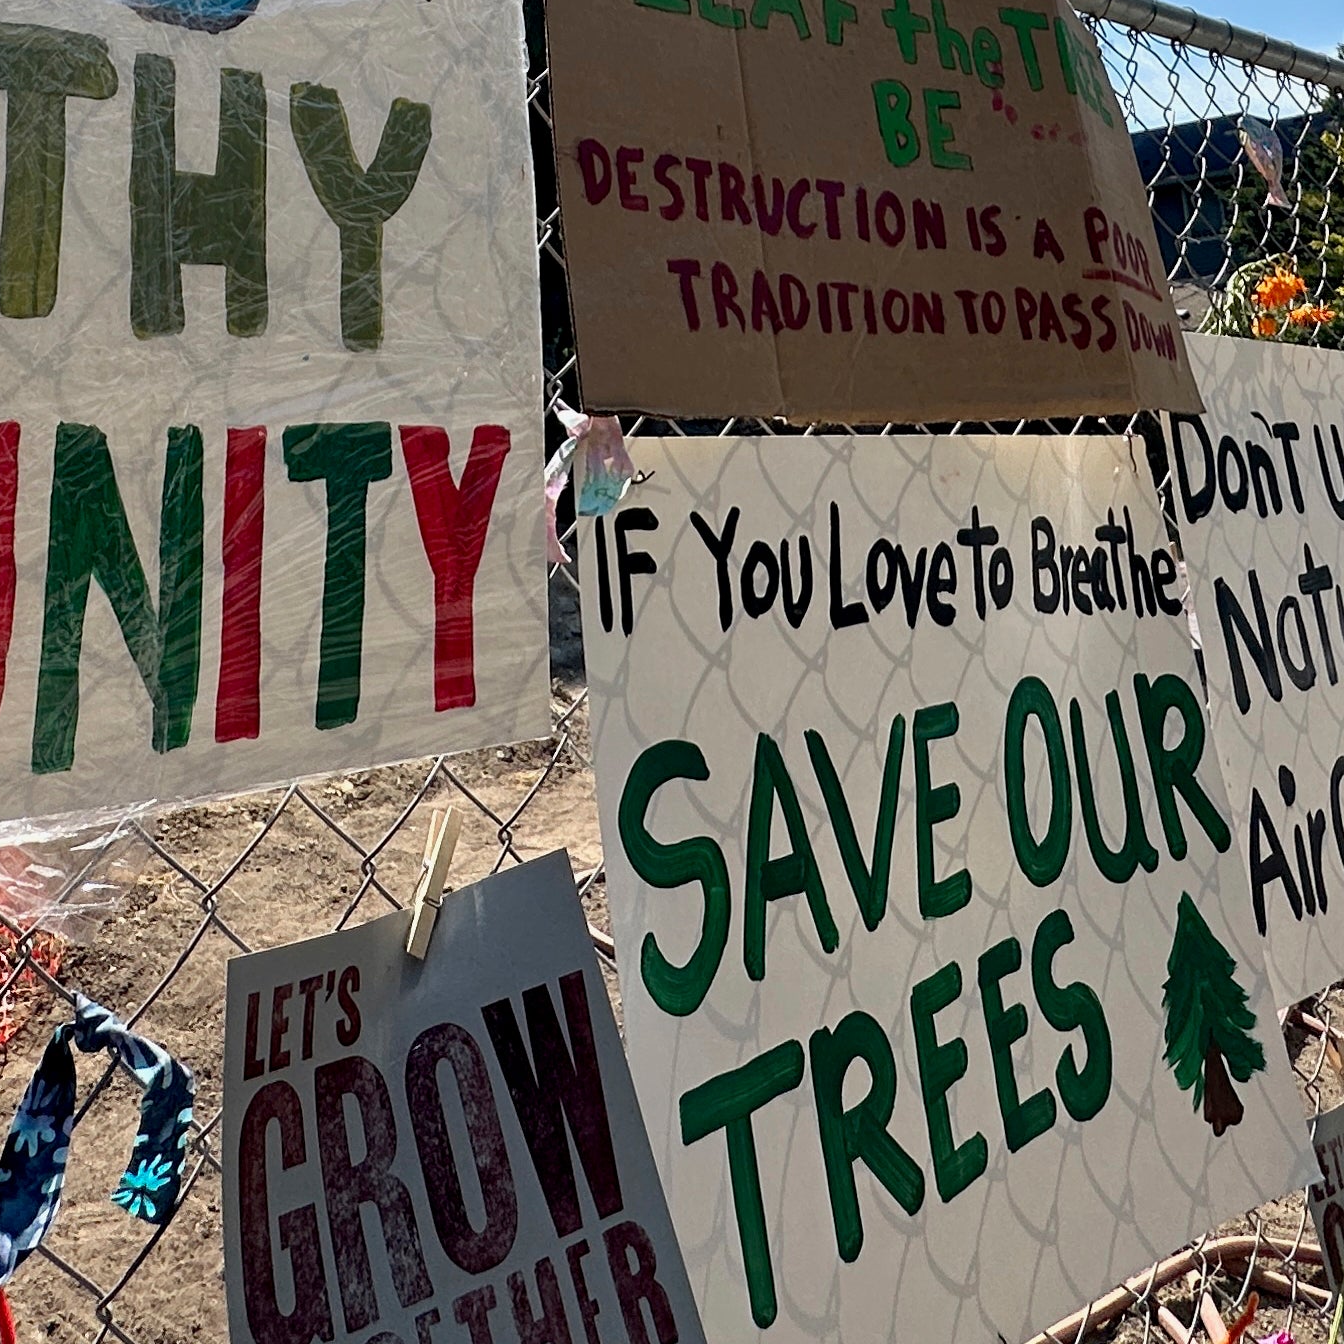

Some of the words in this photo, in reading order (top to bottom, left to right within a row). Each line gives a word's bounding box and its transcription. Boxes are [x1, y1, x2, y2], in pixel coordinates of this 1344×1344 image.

[871, 79, 974, 172] BE
[576, 137, 948, 251] DESTRUCTION
[967, 204, 1007, 256] IS
[1033, 216, 1065, 263] A
[1083, 206, 1156, 289] POOR
[668, 258, 946, 335] TRADITION
[956, 288, 1007, 333] TO
[1018, 287, 1118, 354] PASS
[1123, 299, 1177, 361] DOWN
[595, 507, 660, 637] IF
[829, 501, 958, 631] Love
[1031, 505, 1183, 618] Breathe
[619, 701, 972, 1016] SAVE
[1004, 672, 1231, 885] OUR
[1249, 764, 1328, 937] Air
[243, 965, 361, 1081] LET'S
[238, 969, 624, 1344] GROW
[679, 908, 1112, 1329] TREES
